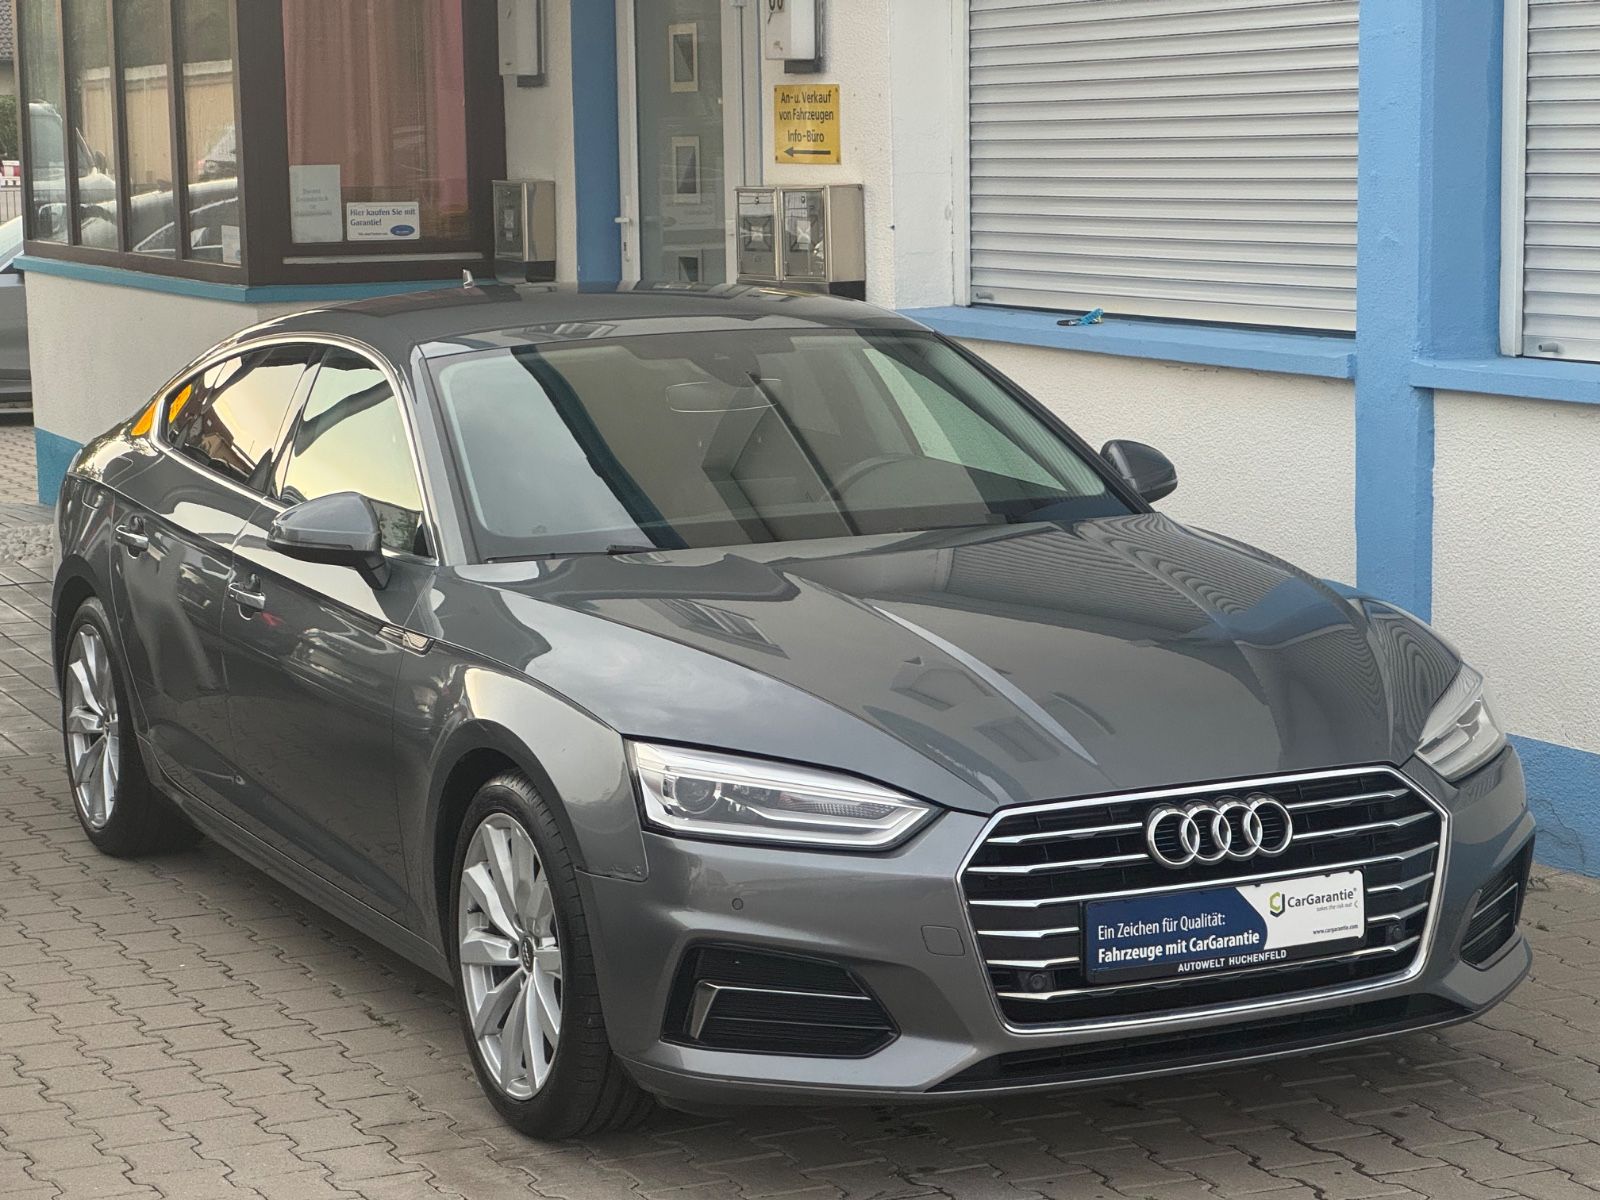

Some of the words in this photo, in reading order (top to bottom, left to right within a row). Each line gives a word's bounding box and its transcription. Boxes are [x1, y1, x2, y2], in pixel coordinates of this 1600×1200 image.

[801, 90, 832, 104] Verkauf
[779, 110, 791, 120] von
[792, 107, 834, 123] Fahrzeugen
[350, 208, 364, 216] Hier
[366, 208, 390, 216] kaufen
[391, 208, 403, 216] Sie
[350, 218, 382, 226] Garantie!
[1098, 925, 1115, 941] Ein
[1117, 921, 1160, 938] Zeichen
[1162, 917, 1178, 932] für
[1180, 912, 1226, 931] Qualität:
[1098, 945, 1163, 964] Fahrzeuge
[1165, 939, 1187, 955] mit
[1189, 930, 1260, 952] CarGarantie
[1177, 958, 1226, 973] AUTOWELT
[1228, 950, 1287, 966] HUCHENFELD
